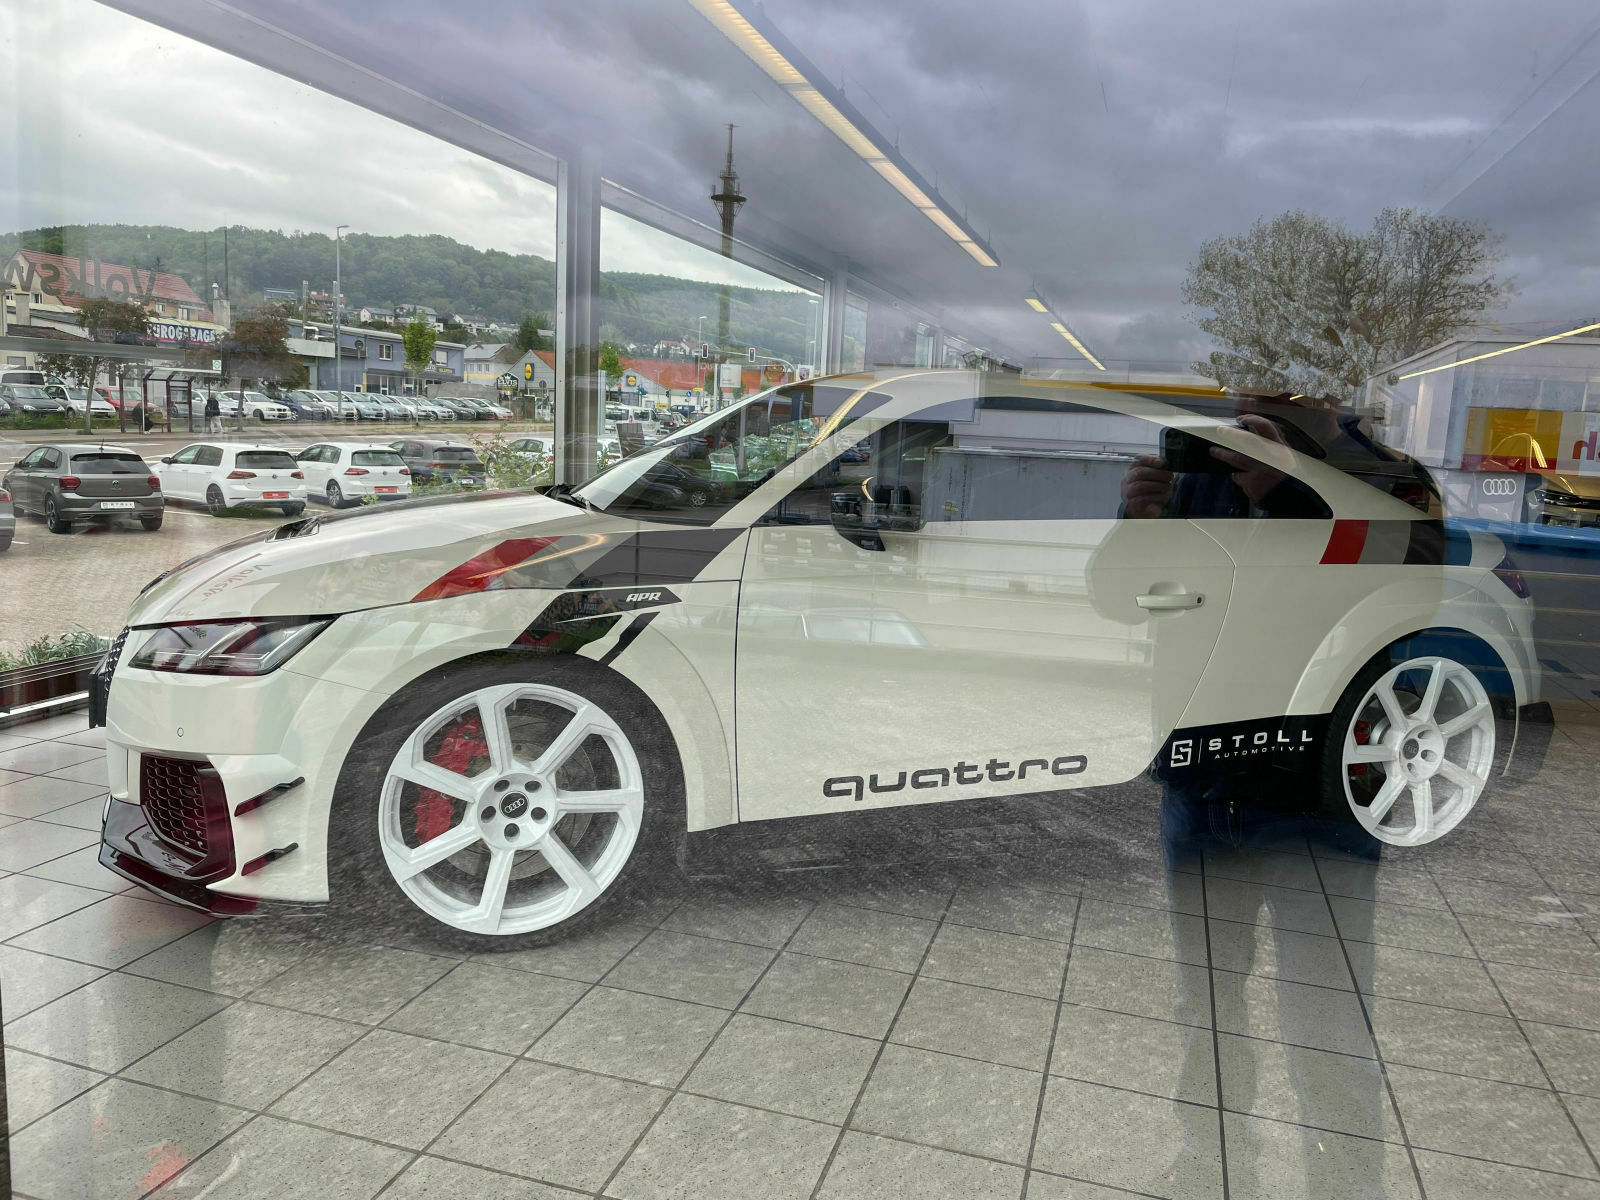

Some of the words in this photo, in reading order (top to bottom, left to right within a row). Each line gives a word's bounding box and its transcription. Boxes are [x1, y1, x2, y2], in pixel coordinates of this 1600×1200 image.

[497, 378, 518, 386] ELVIS
[626, 591, 662, 602] APR
[1208, 729, 1313, 751] STOLL
[1214, 745, 1305, 760] AUTOMOTIVE
[822, 754, 1088, 802] quattro
